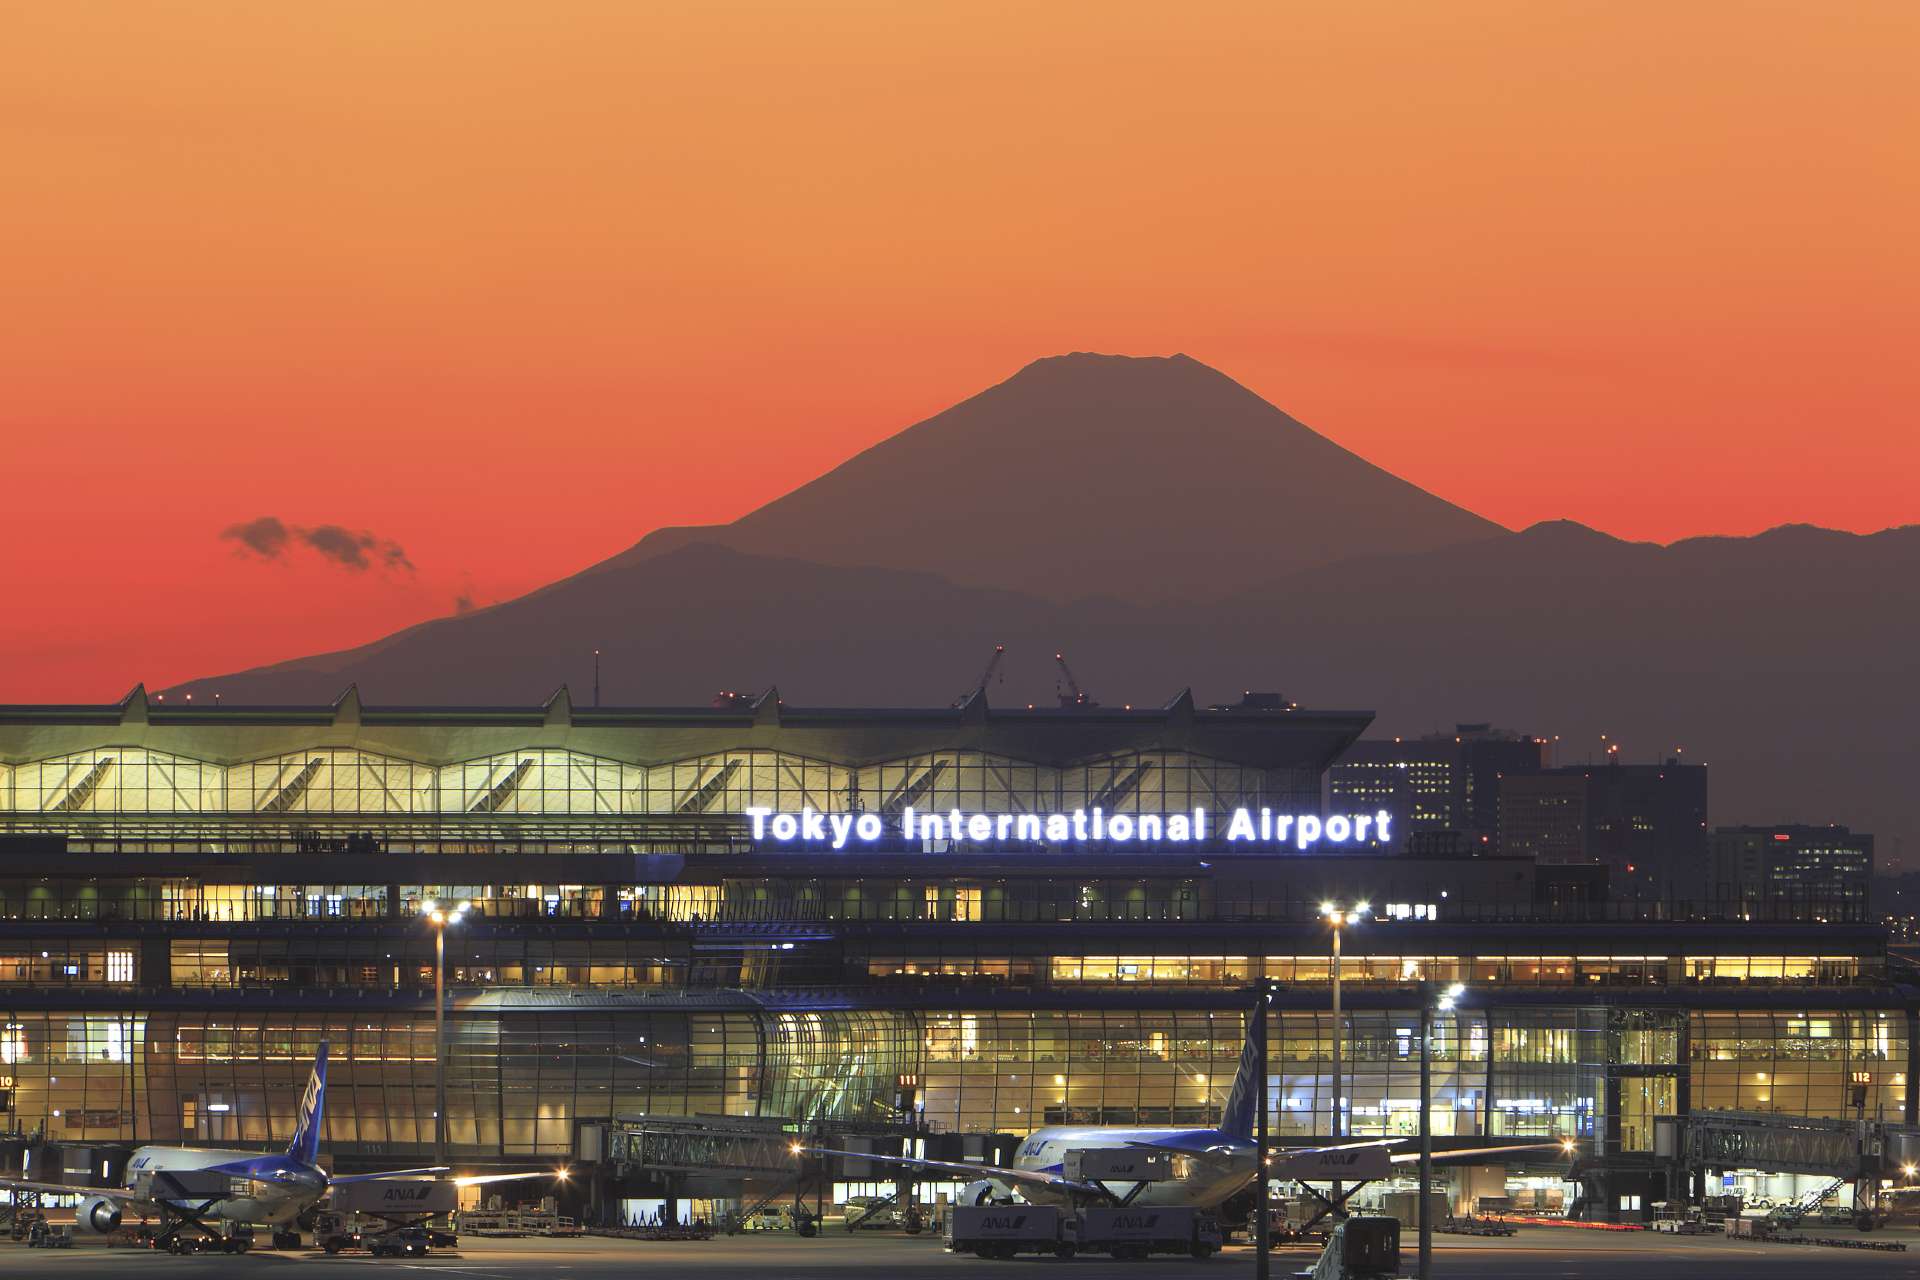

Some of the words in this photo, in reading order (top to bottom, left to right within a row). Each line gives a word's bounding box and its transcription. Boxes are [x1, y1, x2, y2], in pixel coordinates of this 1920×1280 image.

[746, 807, 882, 849] Tokyo
[904, 807, 1204, 840] International
[1228, 807, 1391, 849] Airport
[900, 1075, 916, 1085] 111
[1233, 1030, 1258, 1118] ANA
[1852, 1072, 1870, 1082] 112
[299, 1068, 321, 1147] ANA
[1320, 1154, 1345, 1165] ANA
[384, 1189, 415, 1200] ANA
[981, 1217, 1010, 1229] ANA
[1112, 1216, 1143, 1229] ANA
